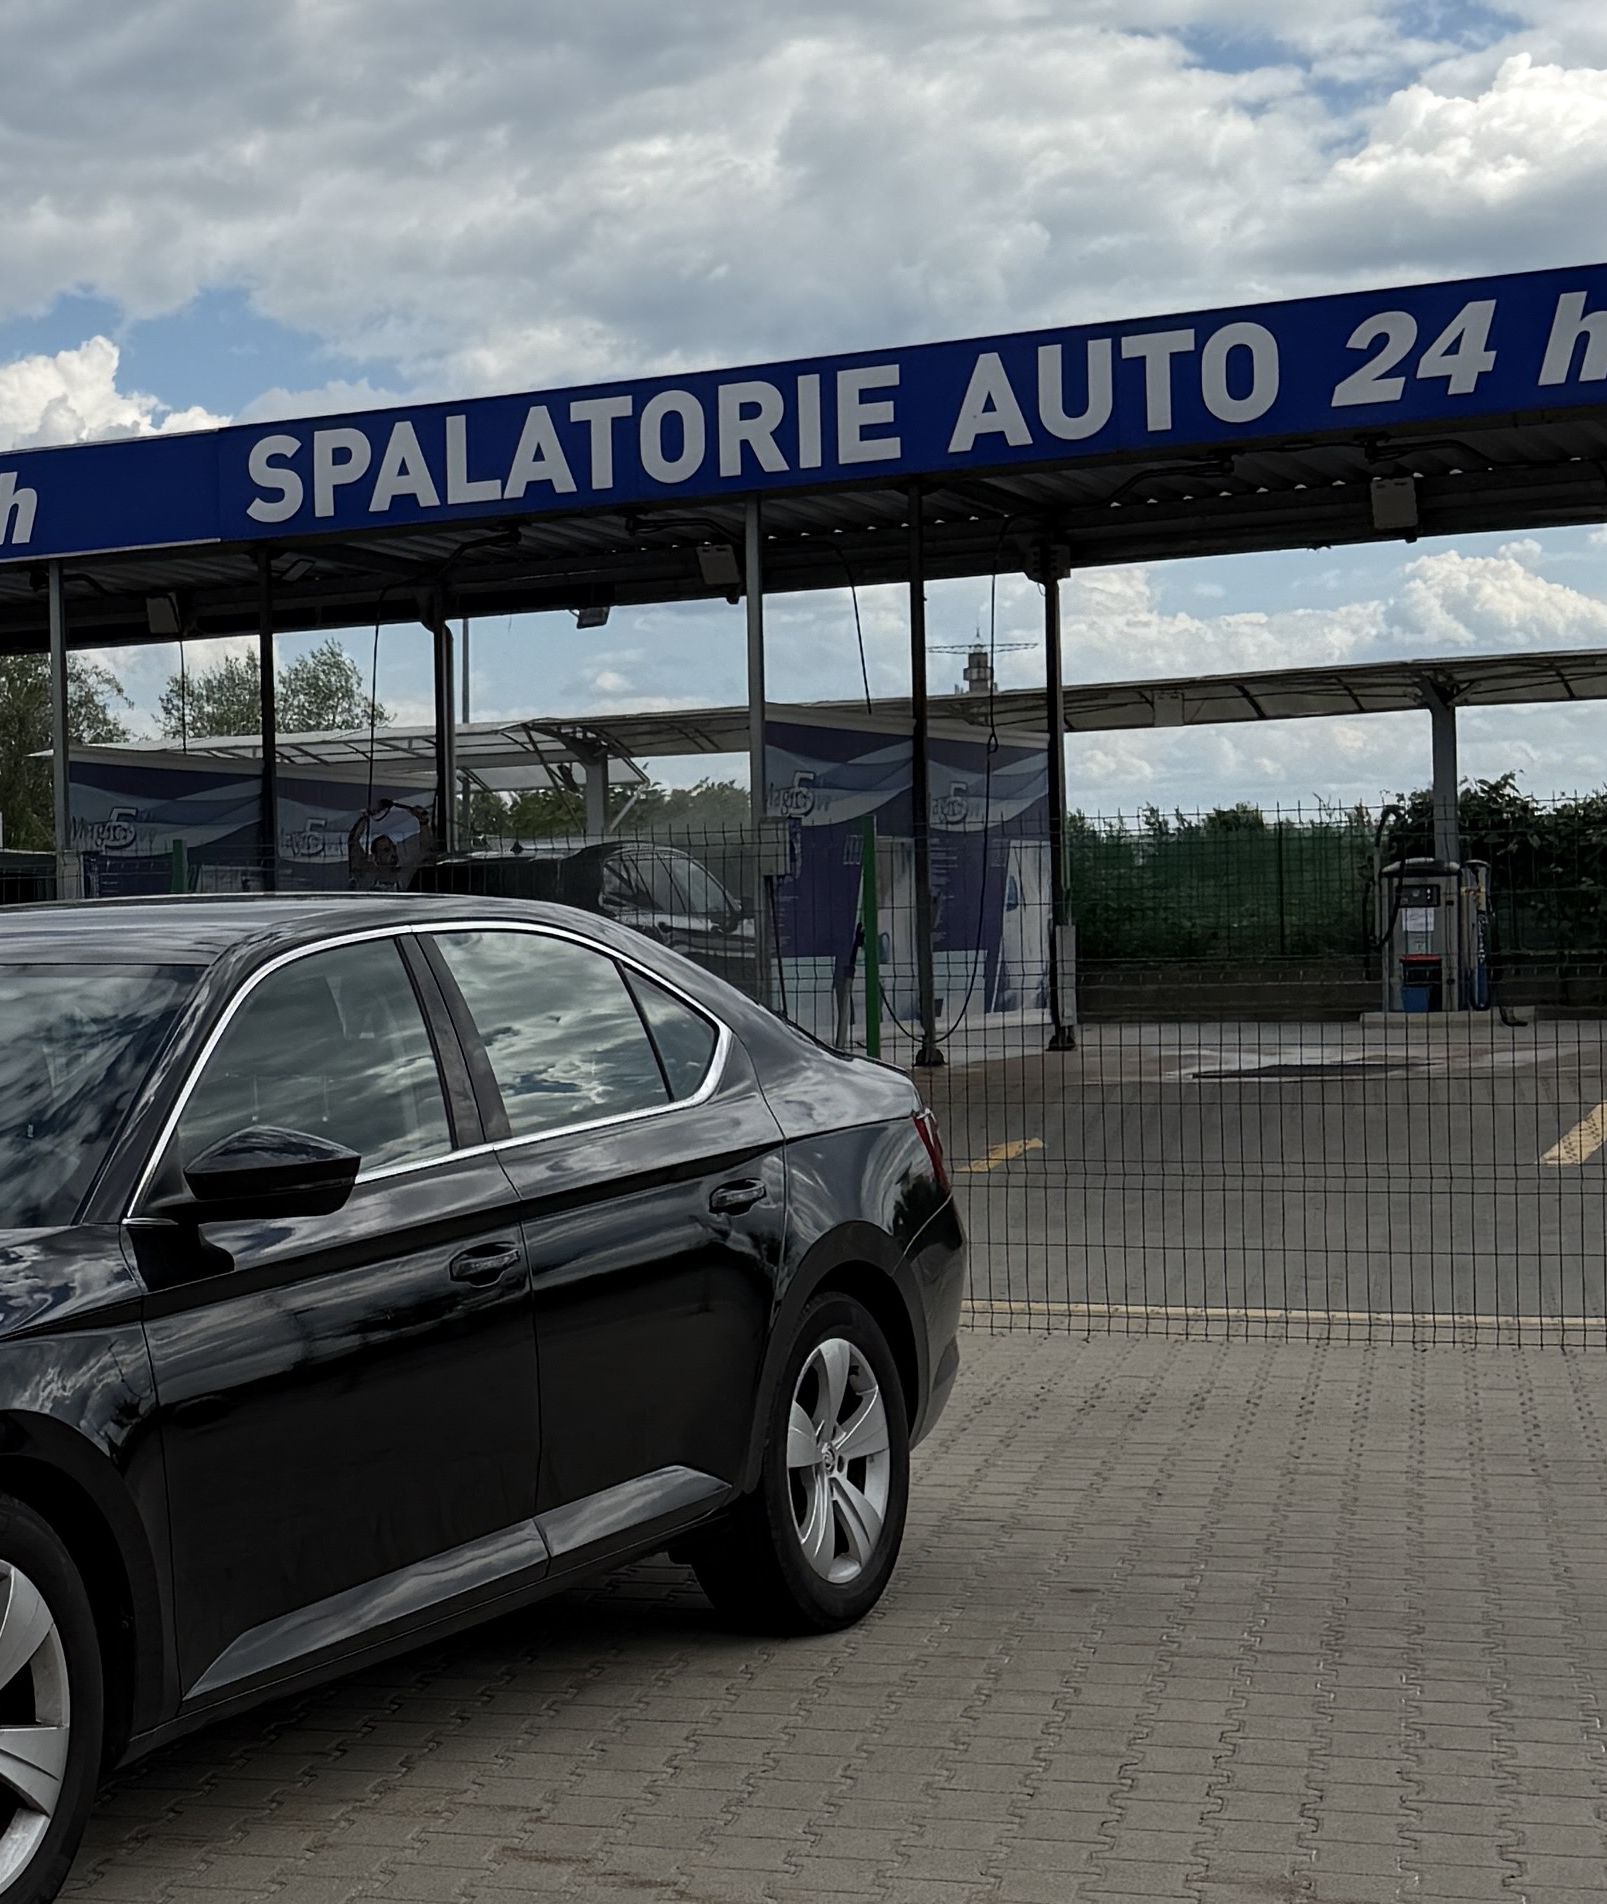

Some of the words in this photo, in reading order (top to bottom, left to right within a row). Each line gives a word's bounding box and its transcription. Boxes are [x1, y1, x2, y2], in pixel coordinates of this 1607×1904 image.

[246, 363, 902, 525] SPALATORIE
[947, 322, 1280, 454] AUTO
[1330, 298, 1498, 409] 24
[1537, 290, 1607, 387] h
